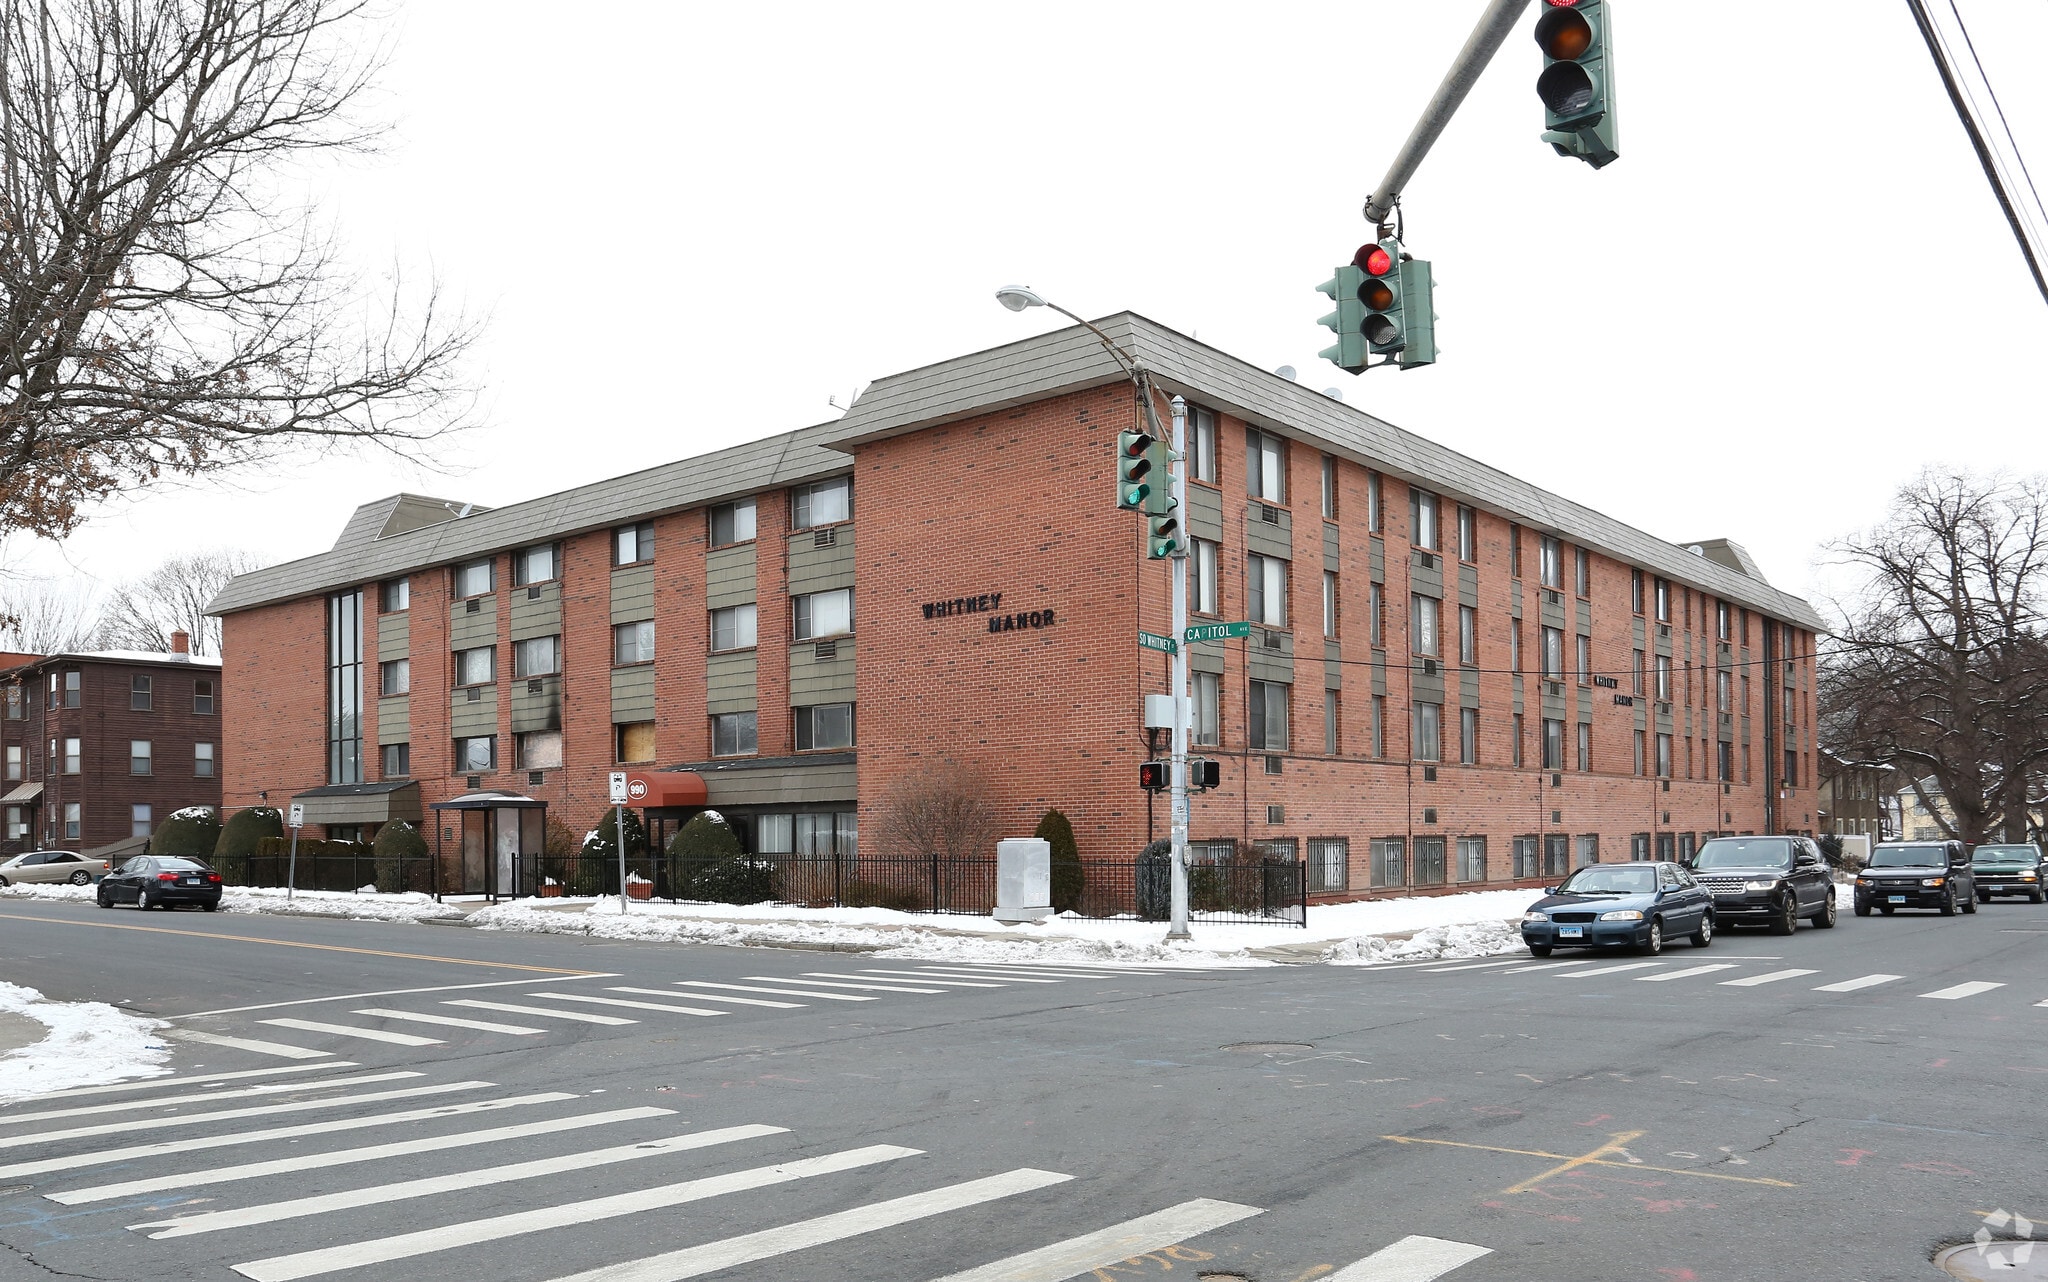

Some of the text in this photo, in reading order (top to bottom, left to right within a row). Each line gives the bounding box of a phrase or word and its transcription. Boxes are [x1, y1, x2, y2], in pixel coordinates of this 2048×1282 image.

[922, 593, 1002, 619] WHITNEY
[988, 609, 1055, 633] MANOR
[1139, 632, 1147, 645] SO
[1147, 634, 1171, 651] WHITNEY
[1187, 625, 1232, 640] CAPITOL
[630, 784, 645, 795] 990
